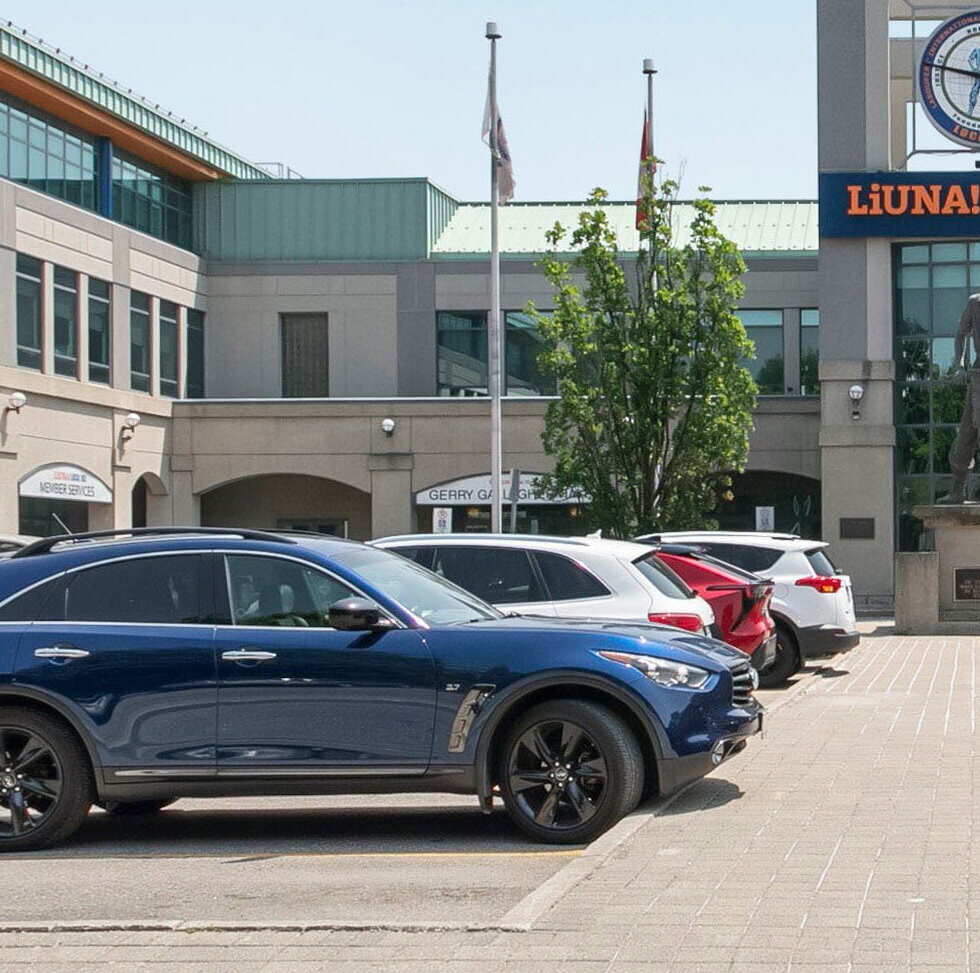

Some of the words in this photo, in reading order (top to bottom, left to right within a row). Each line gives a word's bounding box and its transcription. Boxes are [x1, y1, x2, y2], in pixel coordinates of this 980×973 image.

[934, 54, 944, 87] JUSTCE
[847, 183, 980, 215] LiUNA!
[40, 481, 68, 494] MEMBER
[68, 484, 96, 497] SERVICES
[429, 489, 474, 501] GERRY
